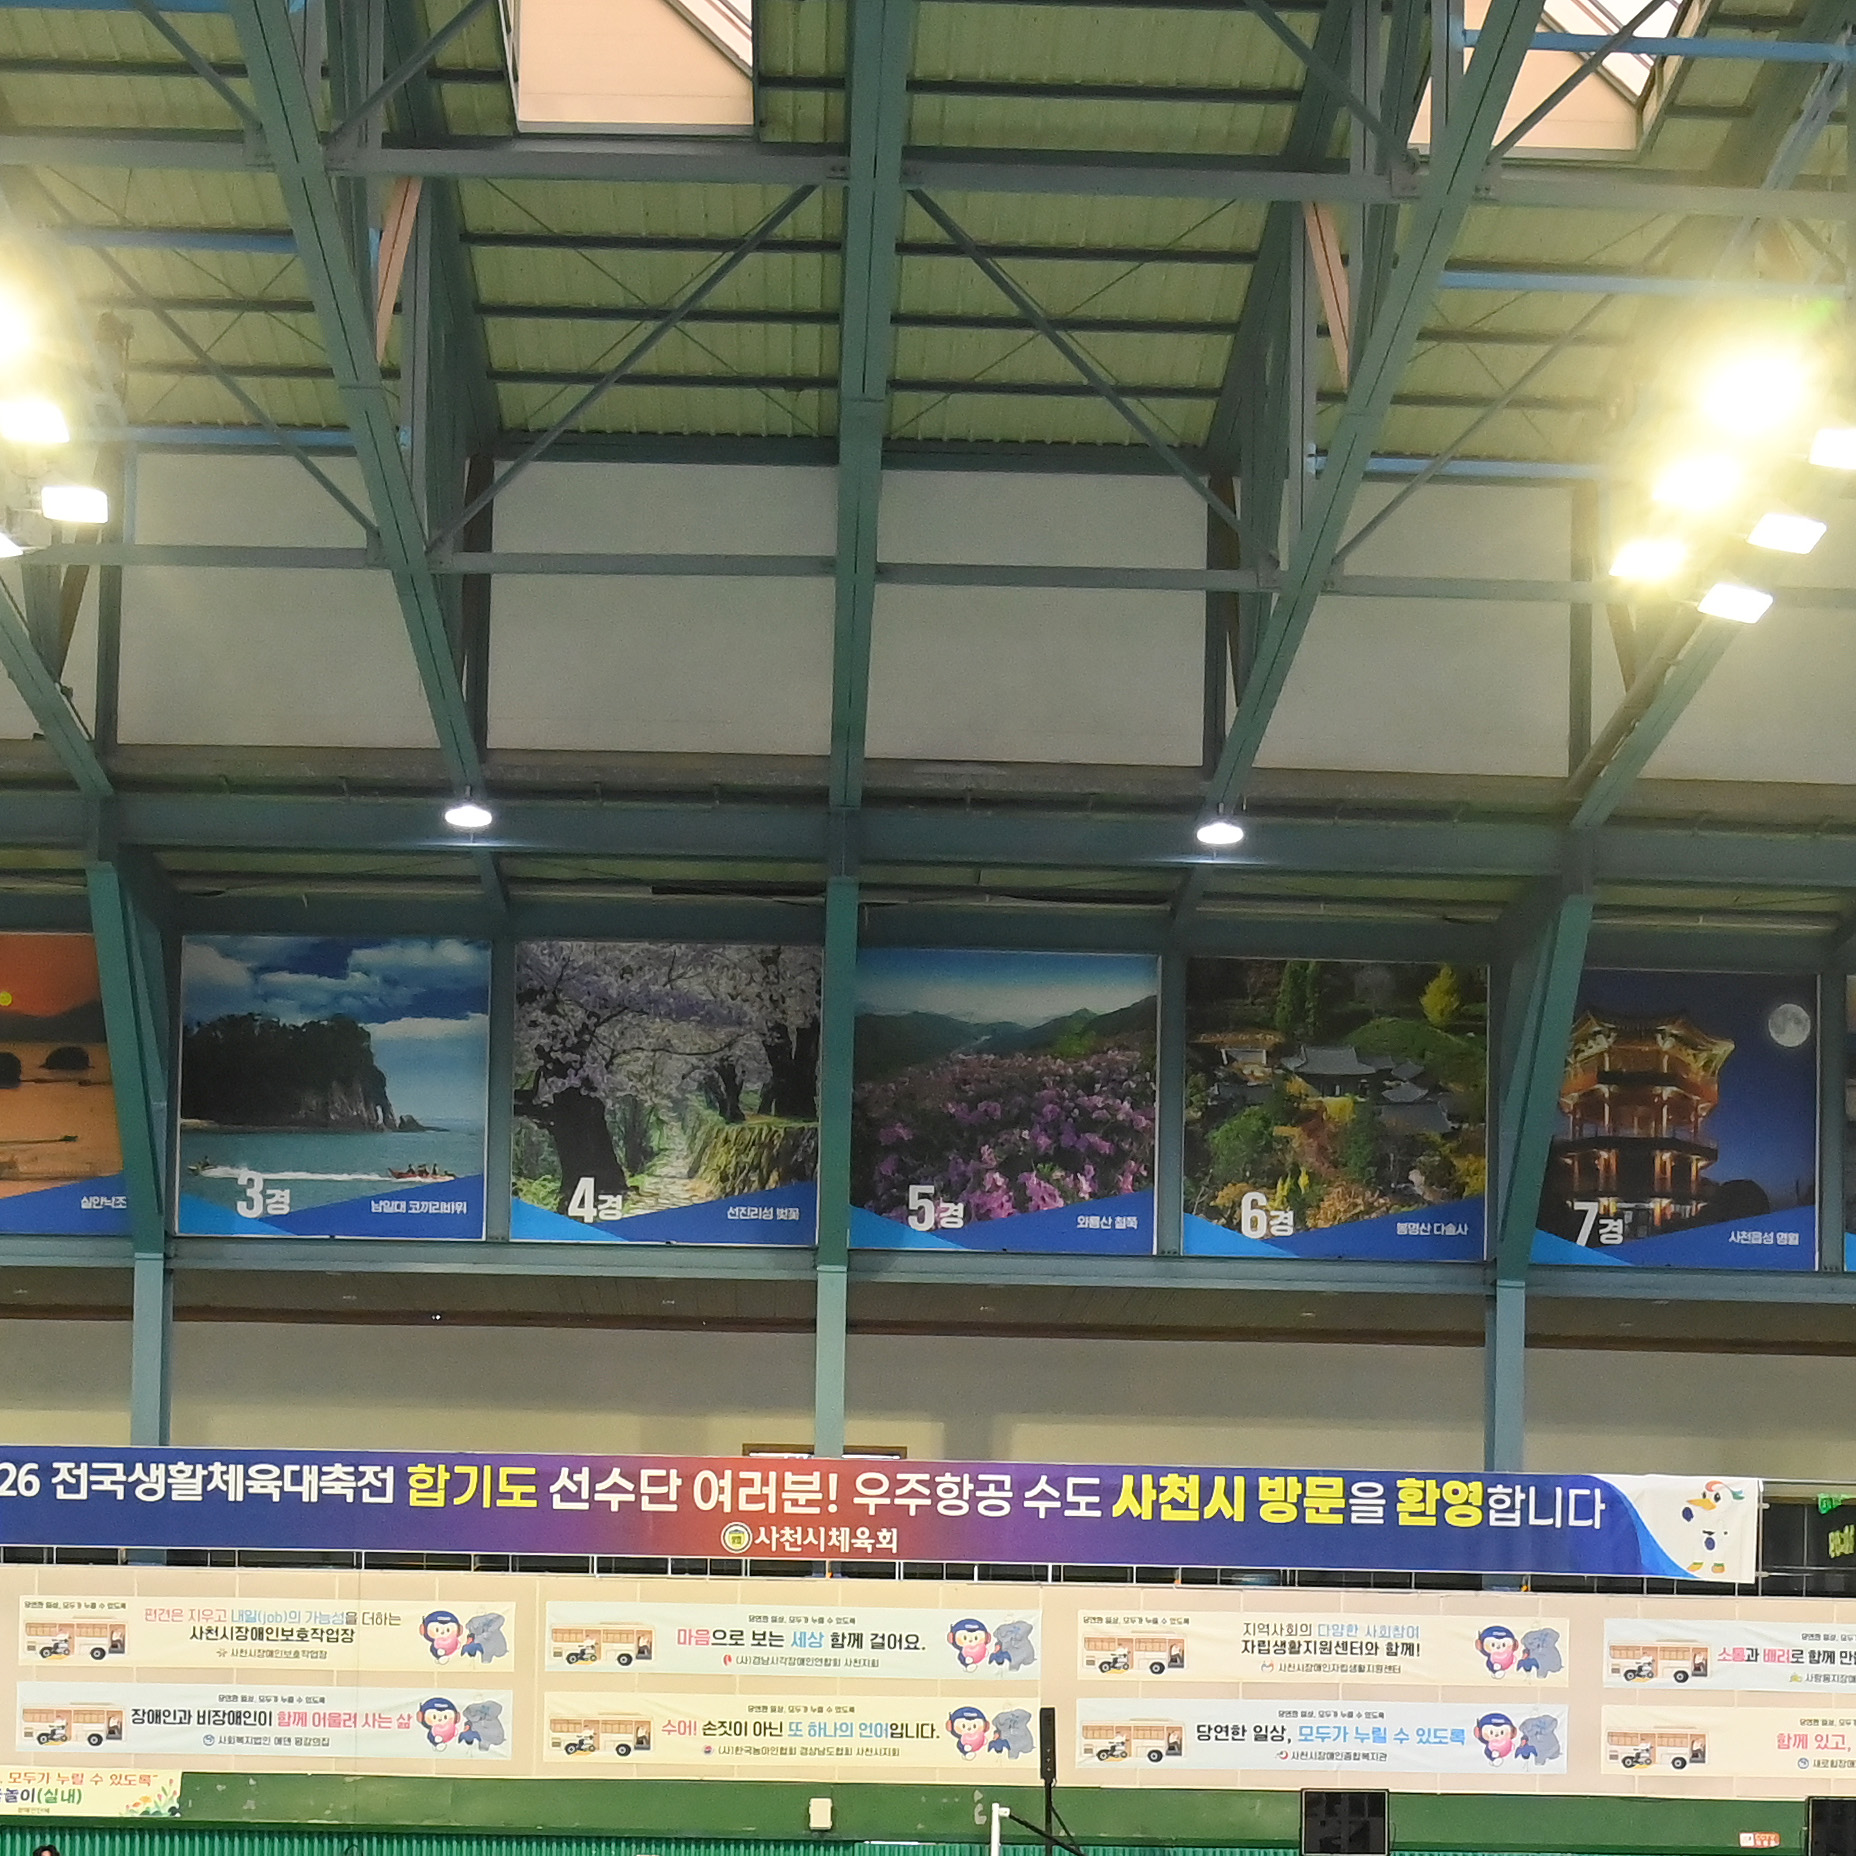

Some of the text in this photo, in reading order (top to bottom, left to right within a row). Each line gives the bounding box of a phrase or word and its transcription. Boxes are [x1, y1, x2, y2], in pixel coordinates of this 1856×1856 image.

[236, 1172, 291, 1218] 3경
[568, 1177, 623, 1224] 4경
[727, 1204, 772, 1220] 선진리성
[907, 1184, 964, 1231] 5경
[1240, 1191, 1294, 1239] 6경
[1574, 1201, 1624, 1247] 7경
[51, 1462, 394, 1504] 전국생활체육대축전
[407, 1464, 537, 1508] 합기도
[549, 1466, 681, 1511] 선수단
[693, 1468, 840, 1514] 여러분!
[853, 1472, 1013, 1517] 우주항공
[1023, 1475, 1101, 1520] 수도
[1112, 1473, 1246, 1523] 사천시
[1258, 1476, 1386, 1525] 방문을
[1396, 1478, 1605, 1531] 환영합니다
[754, 1525, 898, 1554] 사천시체육회
[144, 1608, 183, 1624] 편견은
[189, 1608, 227, 1624] 지우고
[305, 1610, 357, 1625] 가능성을
[362, 1611, 401, 1626] 더하는
[189, 1626, 355, 1644] 사천시장애인보호작업장
[677, 1629, 926, 1651] 마음으로 보는 세상 함께 걸어요.
[1243, 1622, 1420, 1639] 지역사회의 다양한 사회참여
[1241, 1640, 1420, 1658] 자립생활지원센터와 함께!
[1718, 1648, 1759, 1665] 소통과
[1763, 1648, 1805, 1666] 배려로
[1808, 1649, 1835, 1667] 함께
[131, 1708, 412, 1730] 장애인과 비장애인이 함께 어울려 사는 삶
[662, 1719, 941, 1740] 수어! 손짓이 아닌 또 하나의 언어입니다.
[1197, 1724, 1466, 1745] 당연한 일상, 모두가 누릴 수 있도록
[1777, 1733, 1808, 1750] 함께
[1814, 1734, 1851, 1753] 있고,
[8, 1771, 50, 1785] 모두가
[56, 1772, 85, 1785] 누릴
[91, 1773, 103, 1786] 수
